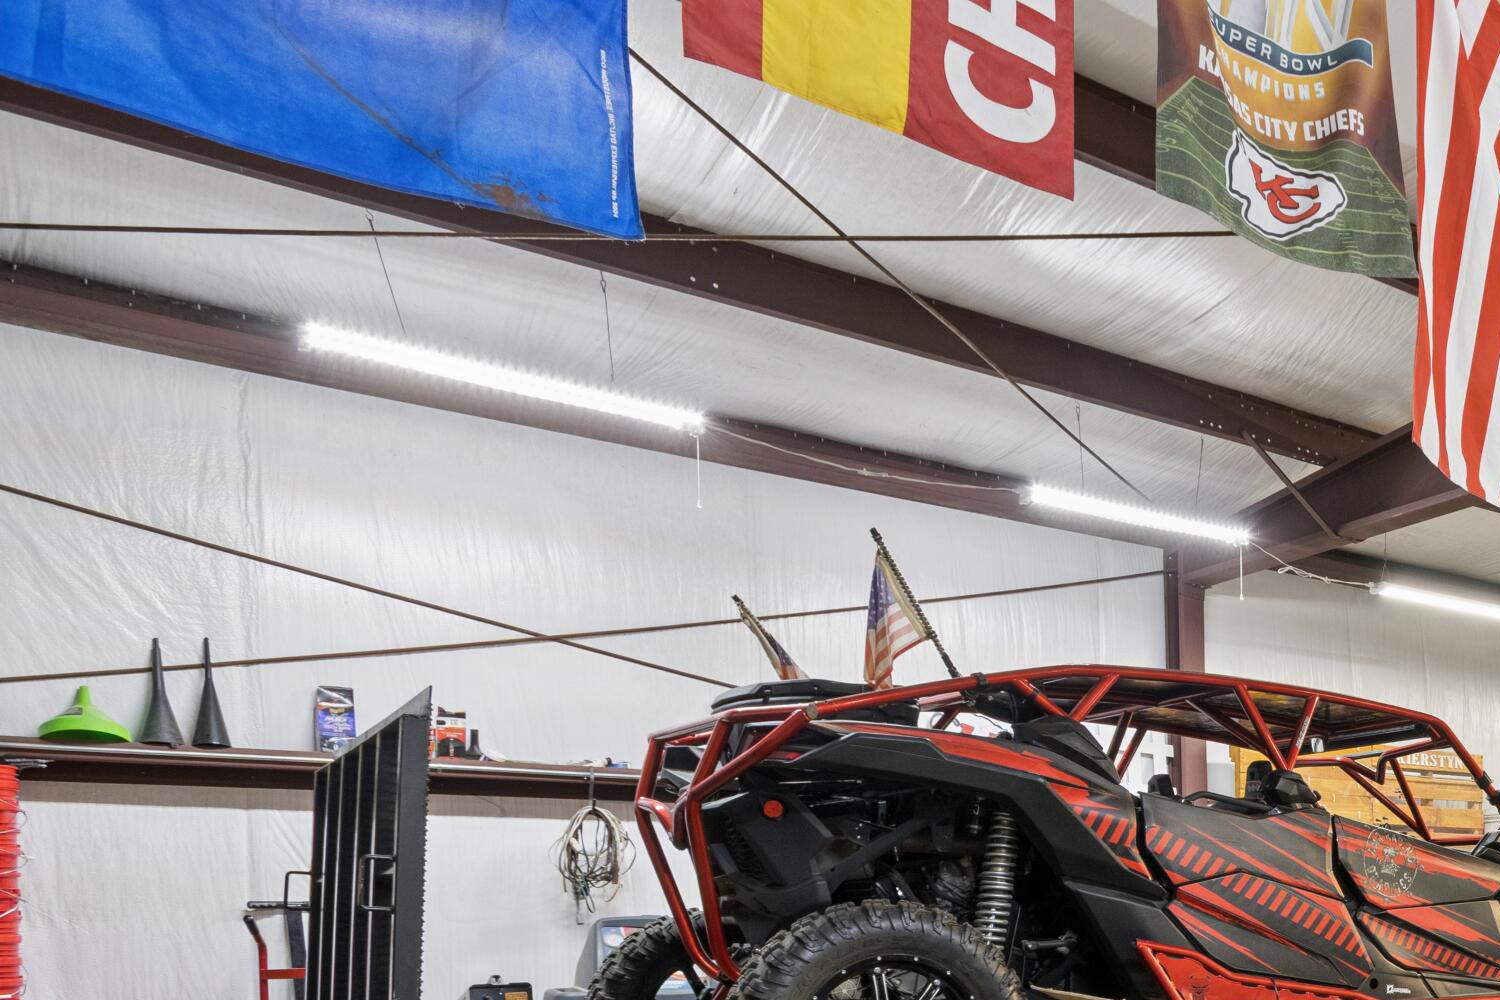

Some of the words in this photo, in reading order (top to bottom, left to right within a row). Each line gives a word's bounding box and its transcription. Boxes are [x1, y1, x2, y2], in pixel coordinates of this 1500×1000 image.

[1216, 42, 1326, 101] HAMPIONS
[1279, 54, 1338, 72] BOWL
[1198, 44, 1252, 127] KASAS
[1254, 111, 1298, 142] CITY
[1303, 108, 1365, 142] CHIEFS
